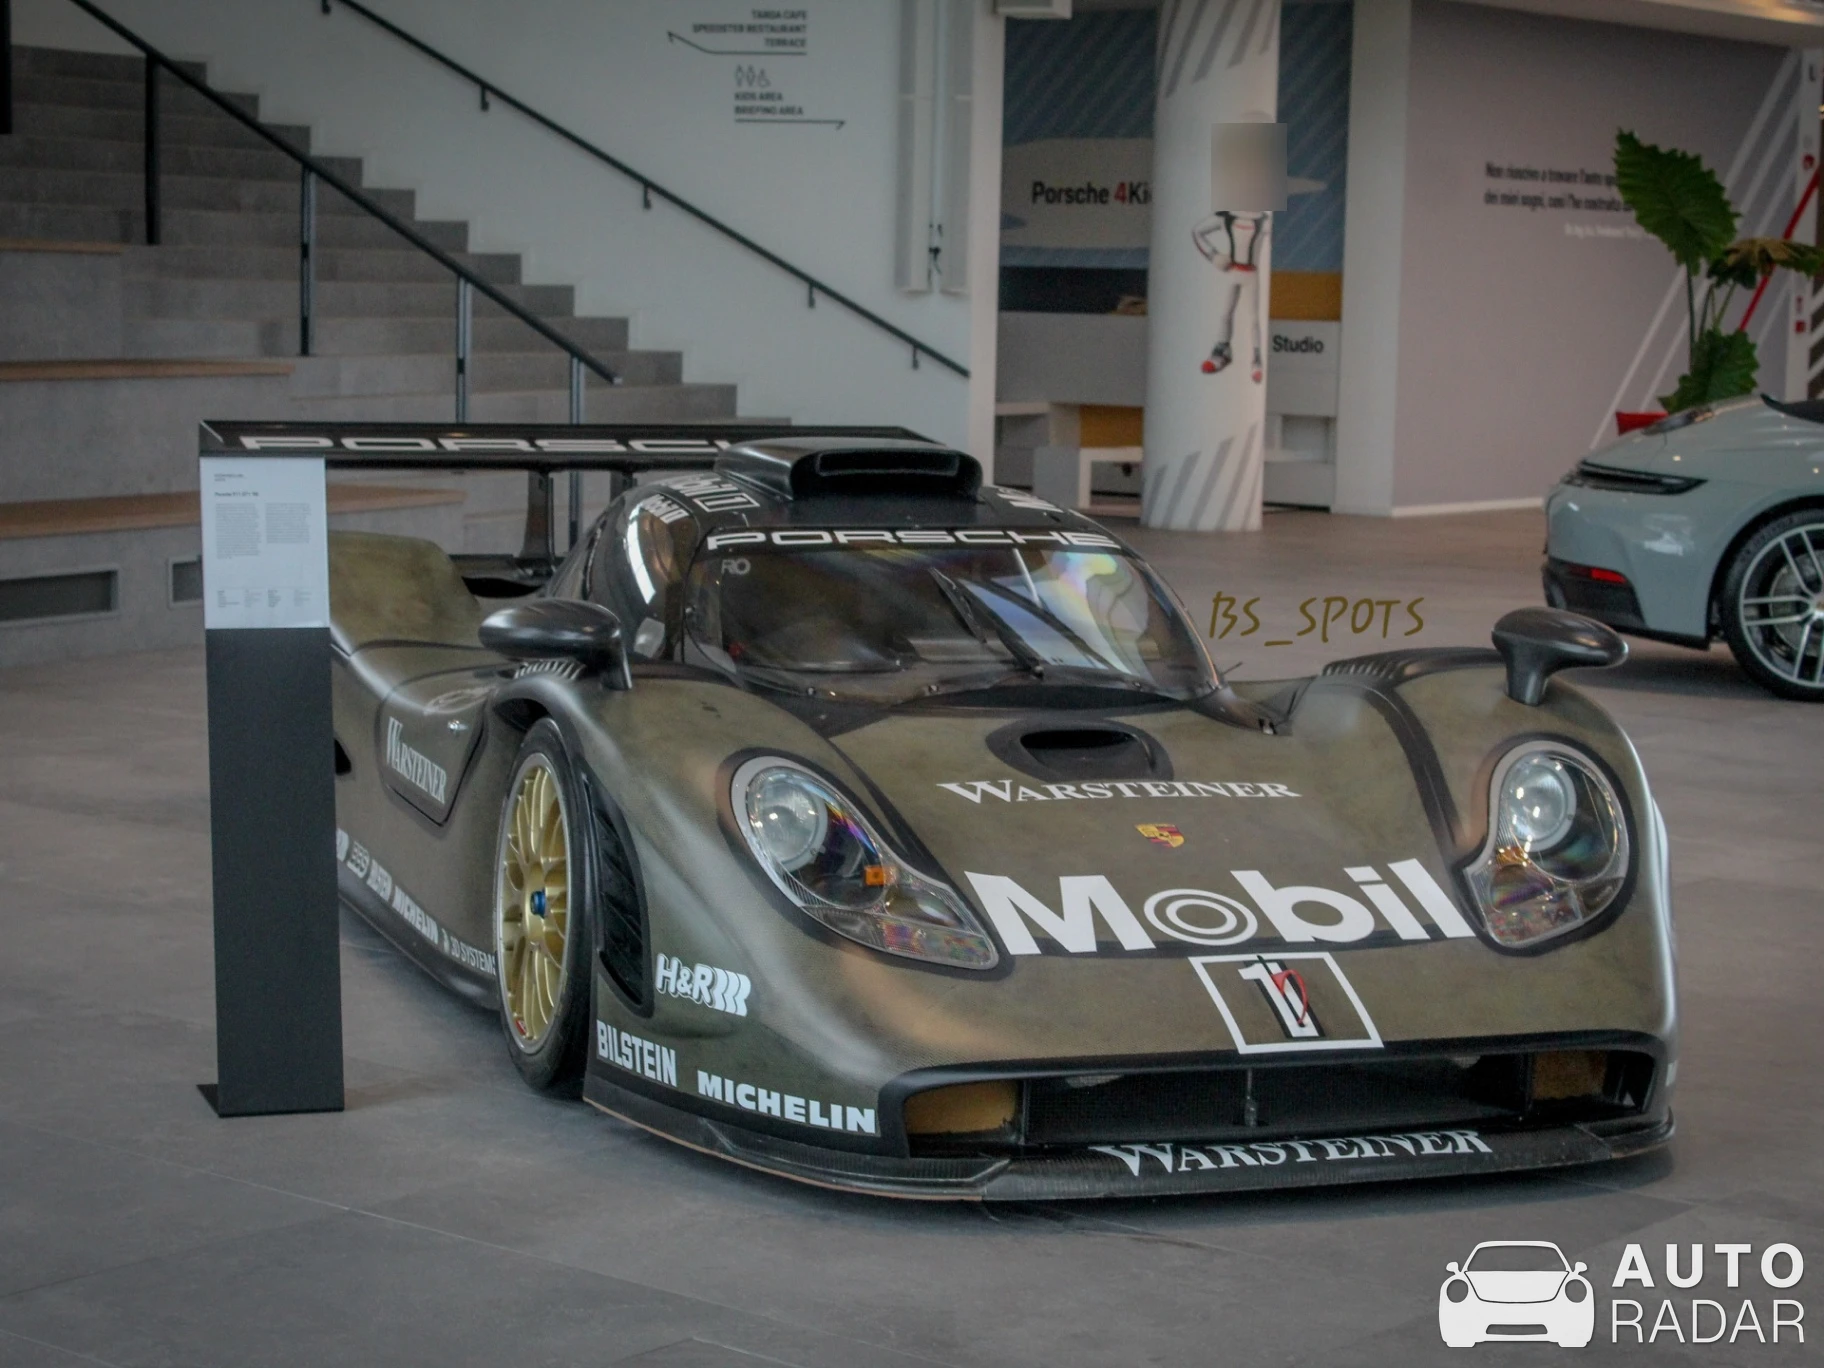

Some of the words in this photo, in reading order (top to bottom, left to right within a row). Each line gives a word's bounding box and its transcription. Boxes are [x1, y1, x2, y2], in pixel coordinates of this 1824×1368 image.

[747, 24, 807, 33] RESTAURANT
[764, 38, 806, 47] TERRACE
[759, 92, 783, 101] AREA
[735, 106, 777, 115] BRIEFING
[779, 106, 803, 115] AREA
[1032, 181, 1109, 204] Porsche
[1114, 182, 1152, 204] 4Ki
[1273, 335, 1324, 353] Studio
[240, 436, 731, 452] PORSC
[706, 529, 1121, 551] PORSCHE
[386, 716, 447, 804] WARSTEINER
[937, 779, 1302, 804] WARSTEINER
[964, 858, 1476, 956] Mobil
[1237, 961, 1323, 1038] 1
[597, 1019, 677, 1088] BILSTEIN
[697, 1069, 876, 1134] MICHELIN
[1089, 1129, 1493, 1177] WARSTEINER
